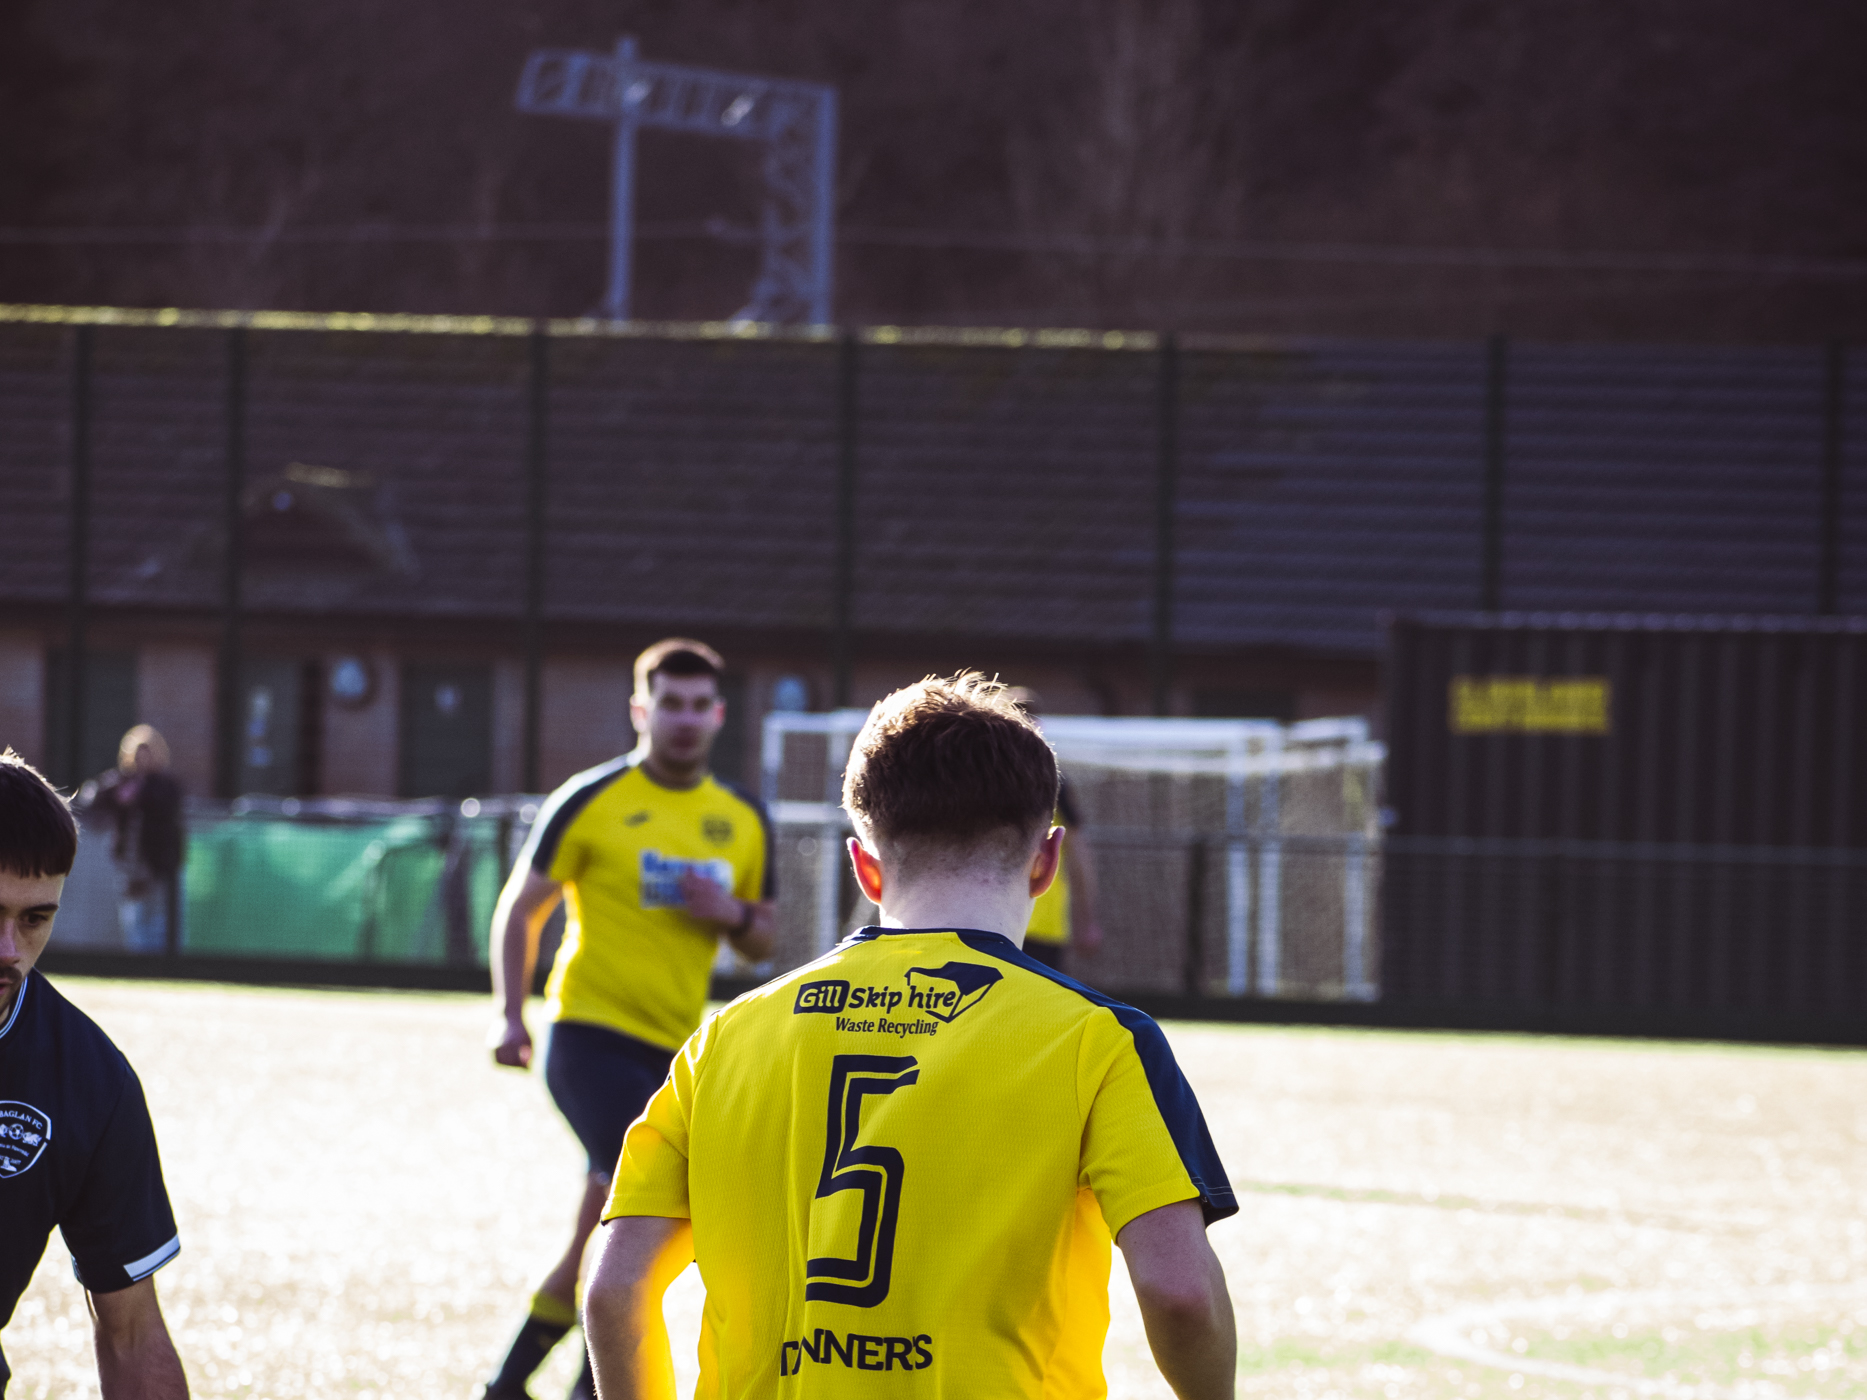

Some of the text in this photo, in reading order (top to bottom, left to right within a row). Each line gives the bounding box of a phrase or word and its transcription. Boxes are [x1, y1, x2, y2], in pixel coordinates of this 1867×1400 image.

[799, 984, 956, 1015] Gill Skip hire
[835, 1016, 940, 1039] Waste Recycling
[32, 1118, 43, 1130] FC
[805, 1054, 920, 1309] 5
